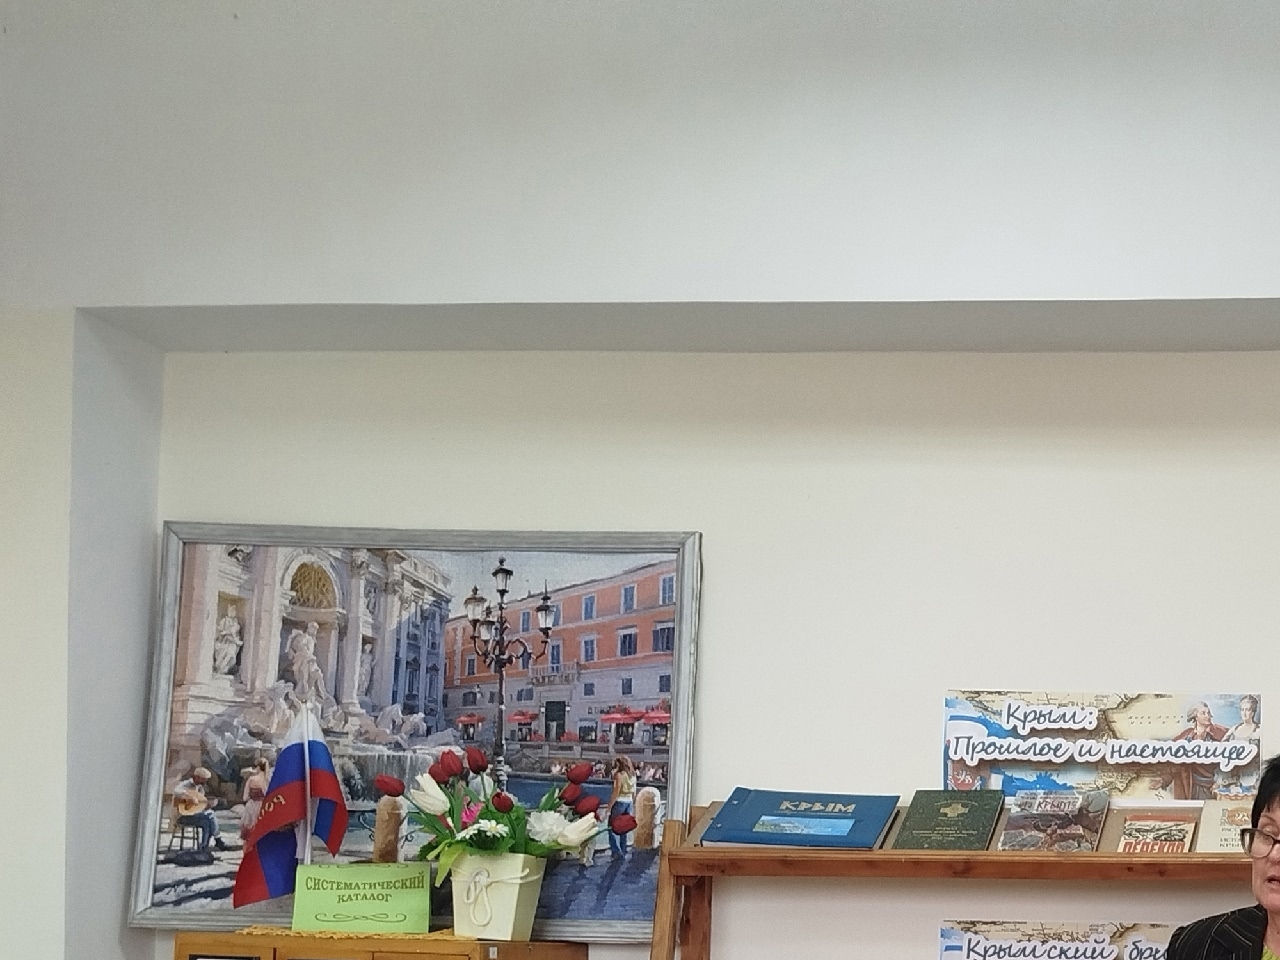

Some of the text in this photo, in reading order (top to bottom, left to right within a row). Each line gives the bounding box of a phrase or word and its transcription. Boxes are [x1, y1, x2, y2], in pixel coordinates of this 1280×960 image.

[1006, 702, 1096, 731] Крым:
[953, 735, 1252, 768] Прошлое и настоящее
[779, 800, 857, 813] КРЫМ
[1122, 841, 1186, 853] ПЕРЕКОП
[305, 871, 425, 891] СИСТЕМАТИЧЕСКИЙ
[337, 892, 392, 903] КАТАЛОГ
